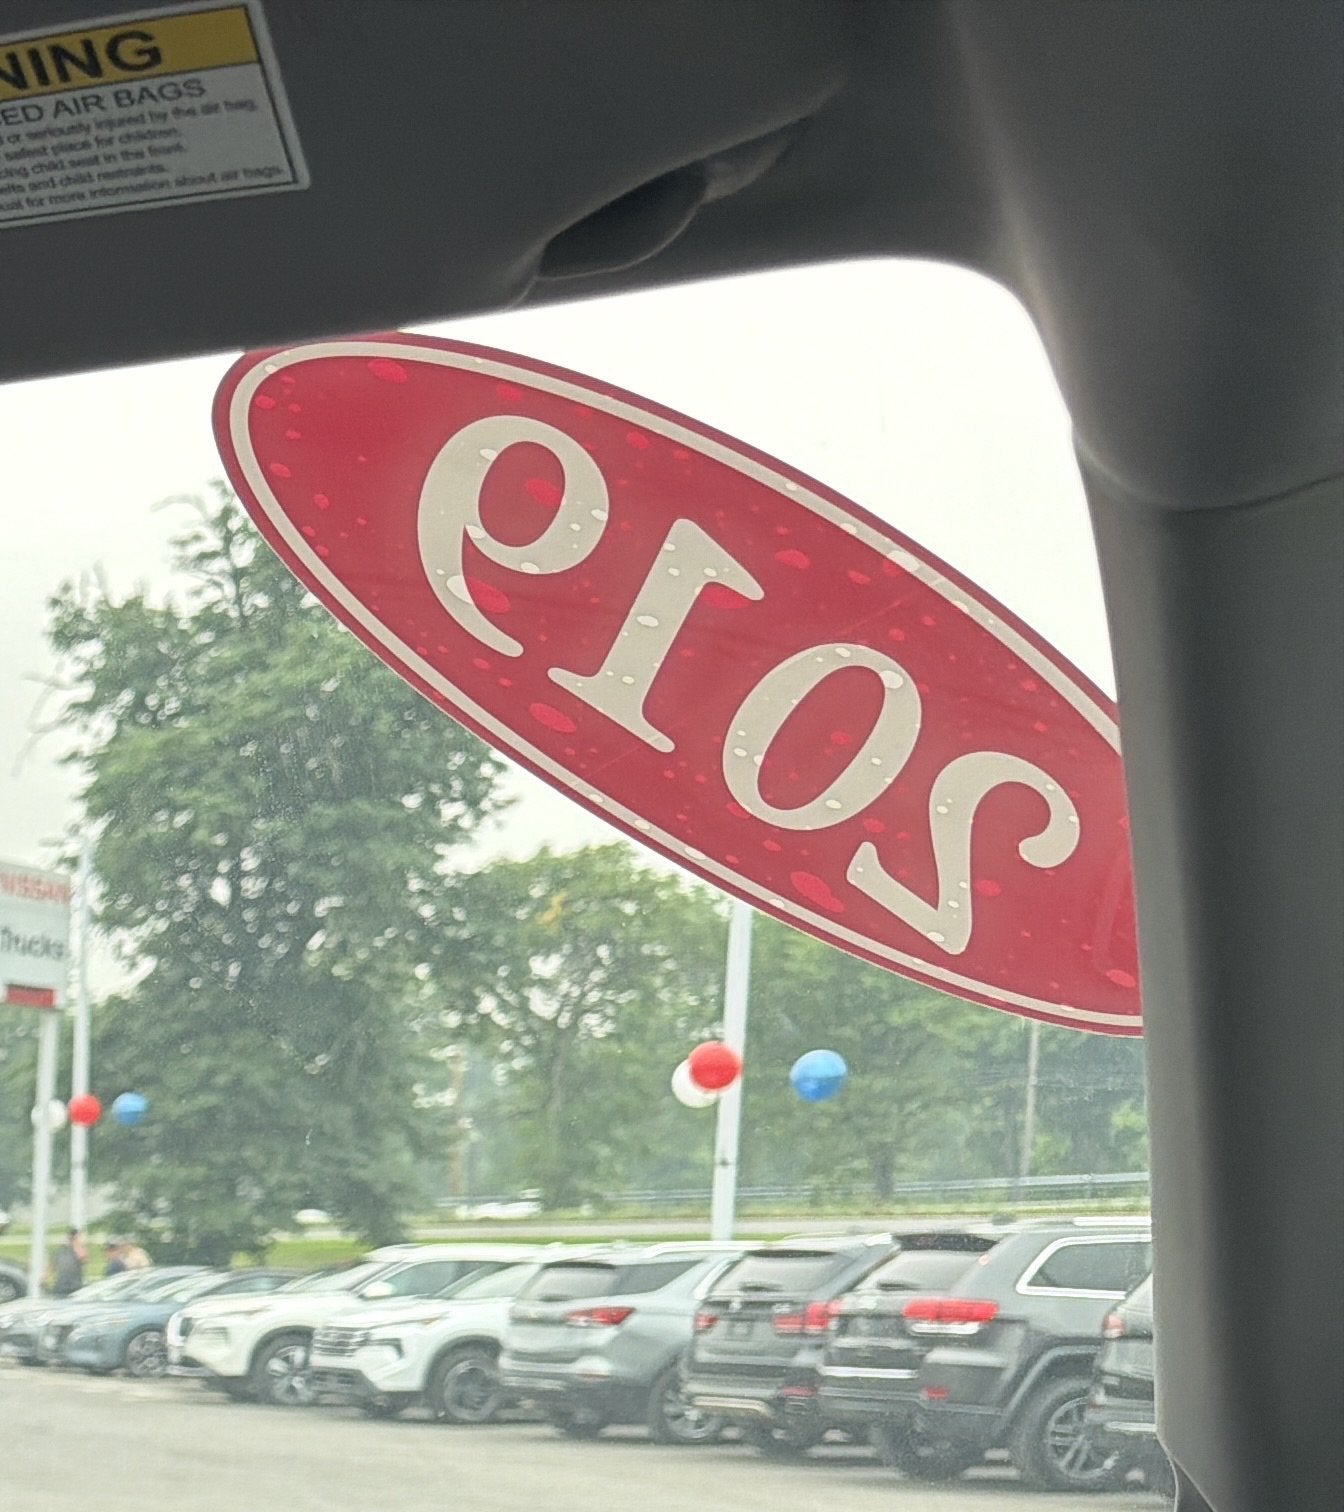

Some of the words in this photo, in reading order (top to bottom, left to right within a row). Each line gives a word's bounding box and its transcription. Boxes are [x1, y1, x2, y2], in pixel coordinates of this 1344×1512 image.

[47, 93, 106, 118] AIR
[111, 77, 207, 109] BAGS
[6, 134, 23, 143] or
